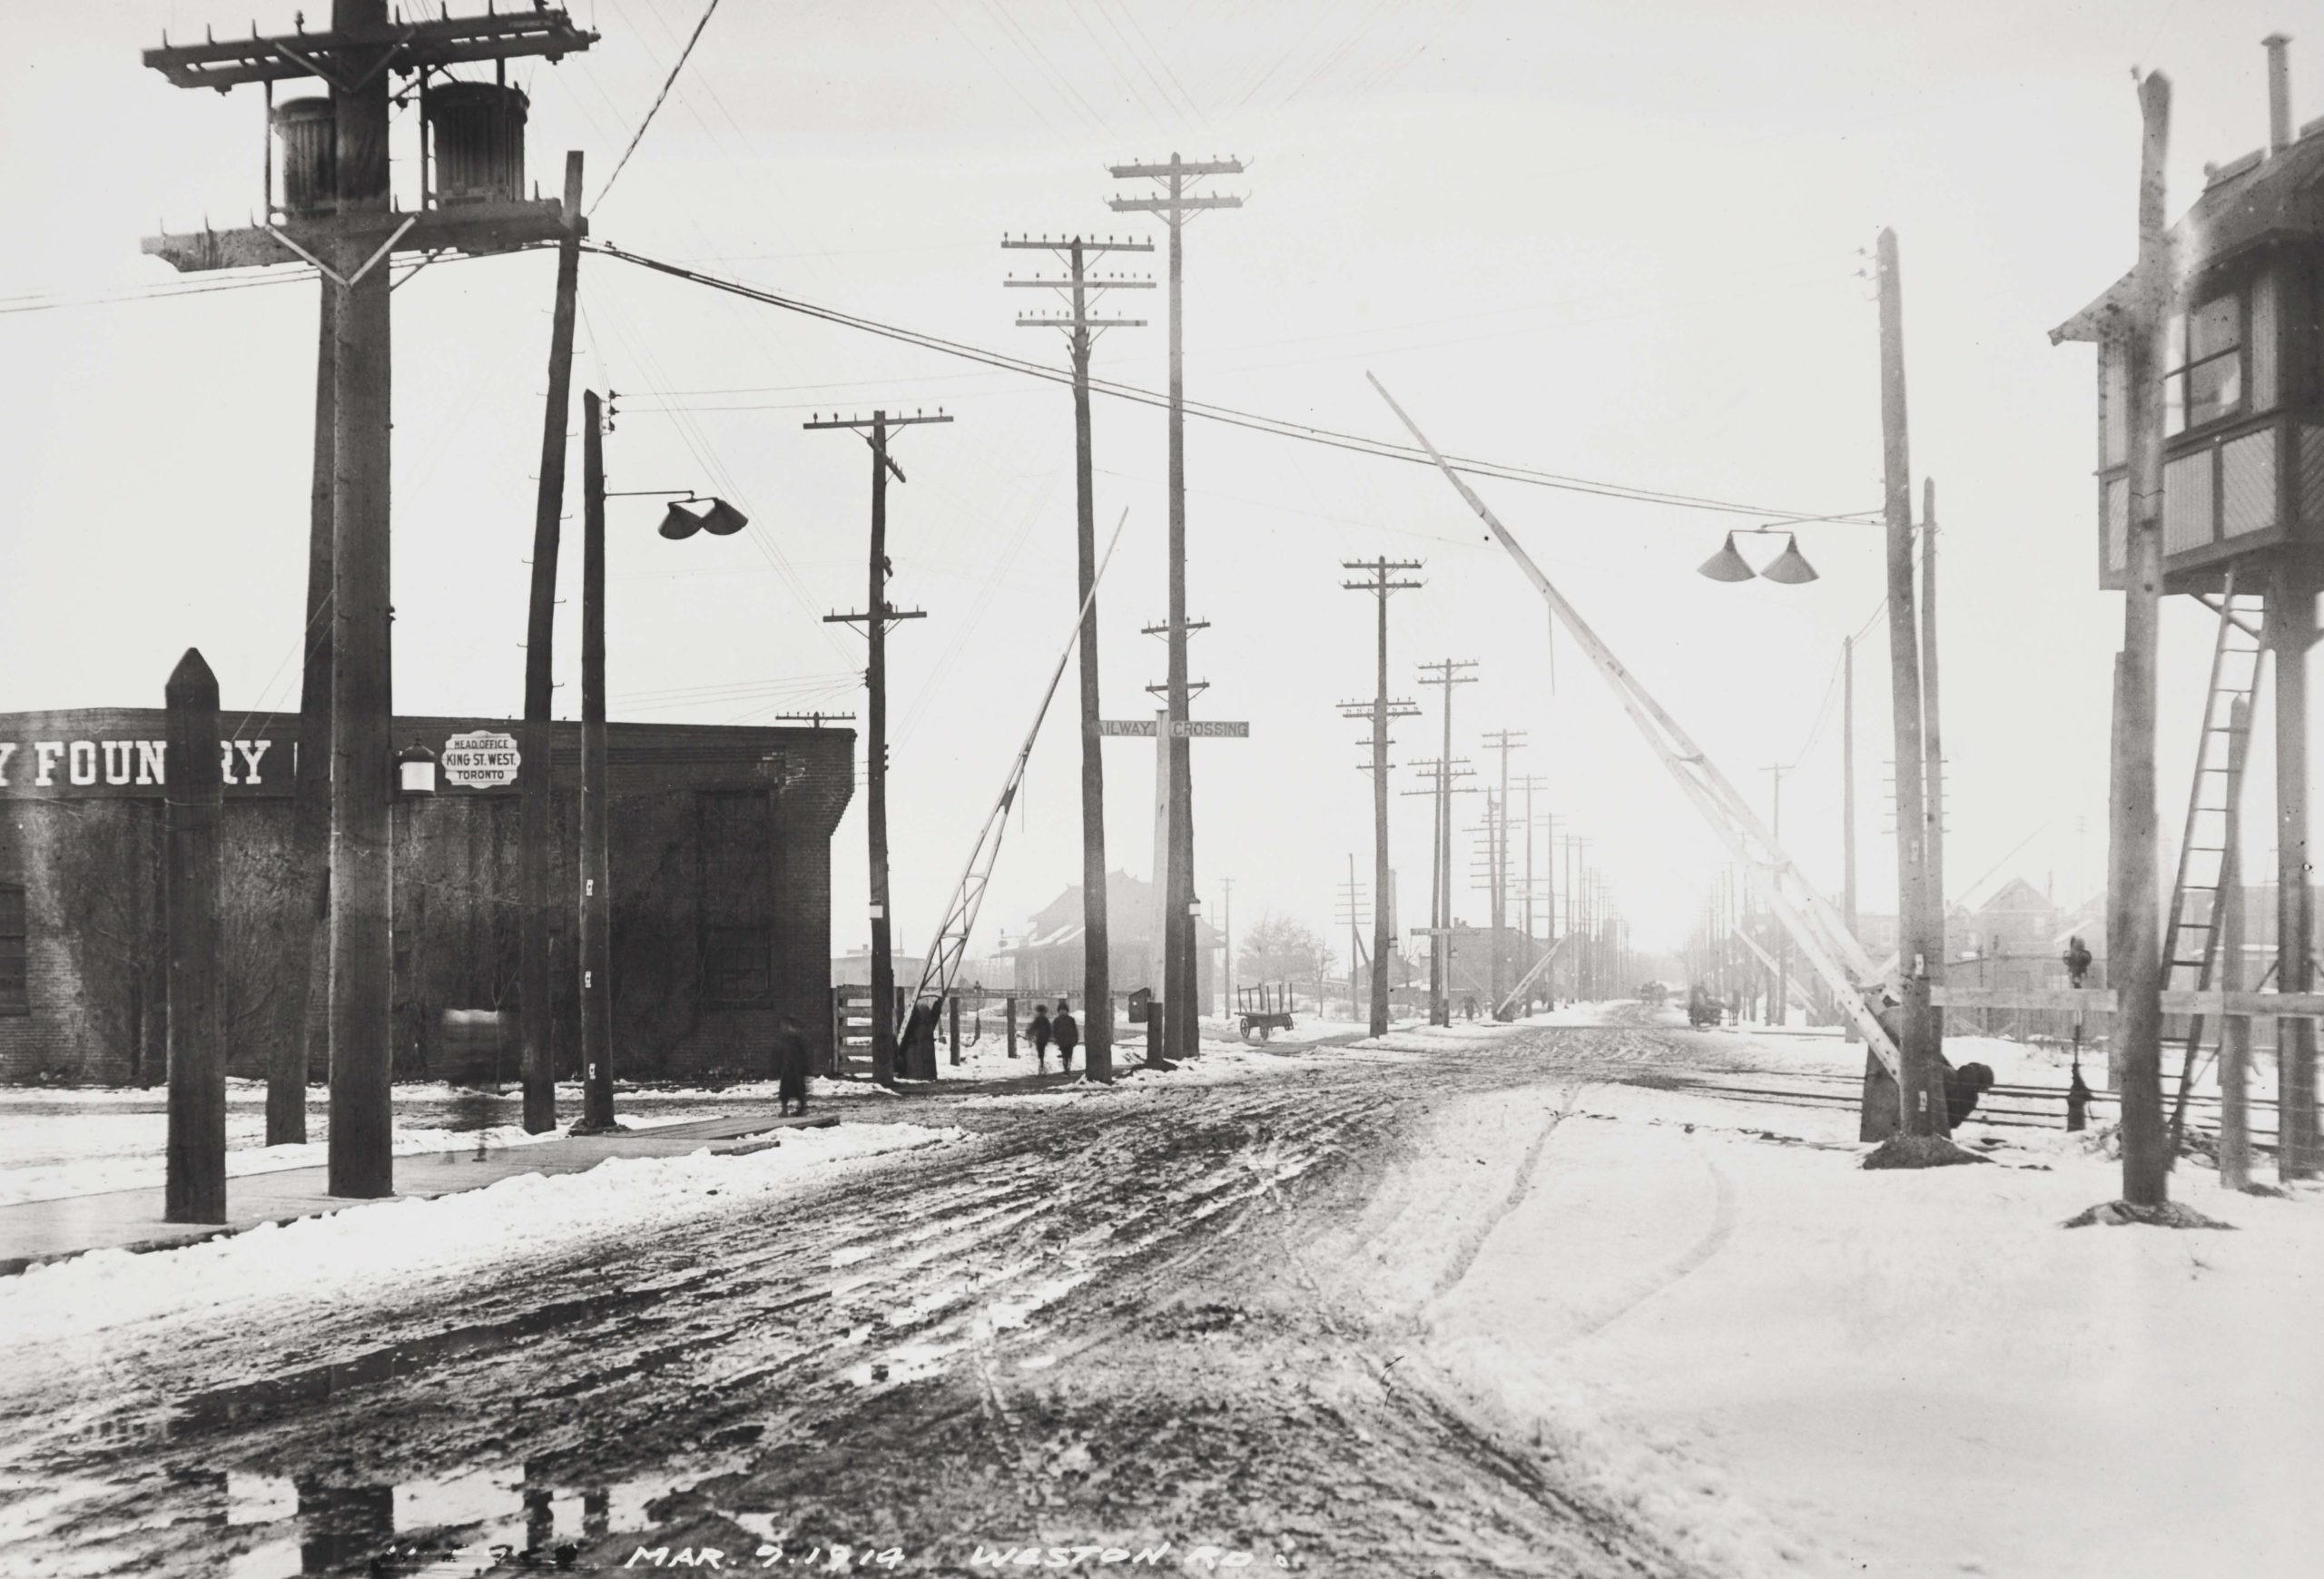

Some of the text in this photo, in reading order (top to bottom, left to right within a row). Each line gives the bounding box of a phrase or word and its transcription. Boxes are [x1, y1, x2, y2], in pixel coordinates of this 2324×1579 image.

[1174, 722, 1248, 735] CROSSING
[454, 739, 508, 749] HEAD OFFICE
[34, 740, 271, 785] FOUNRY
[447, 753, 517, 765] KING ST. WEST.
[457, 770, 505, 780] TORONTO
